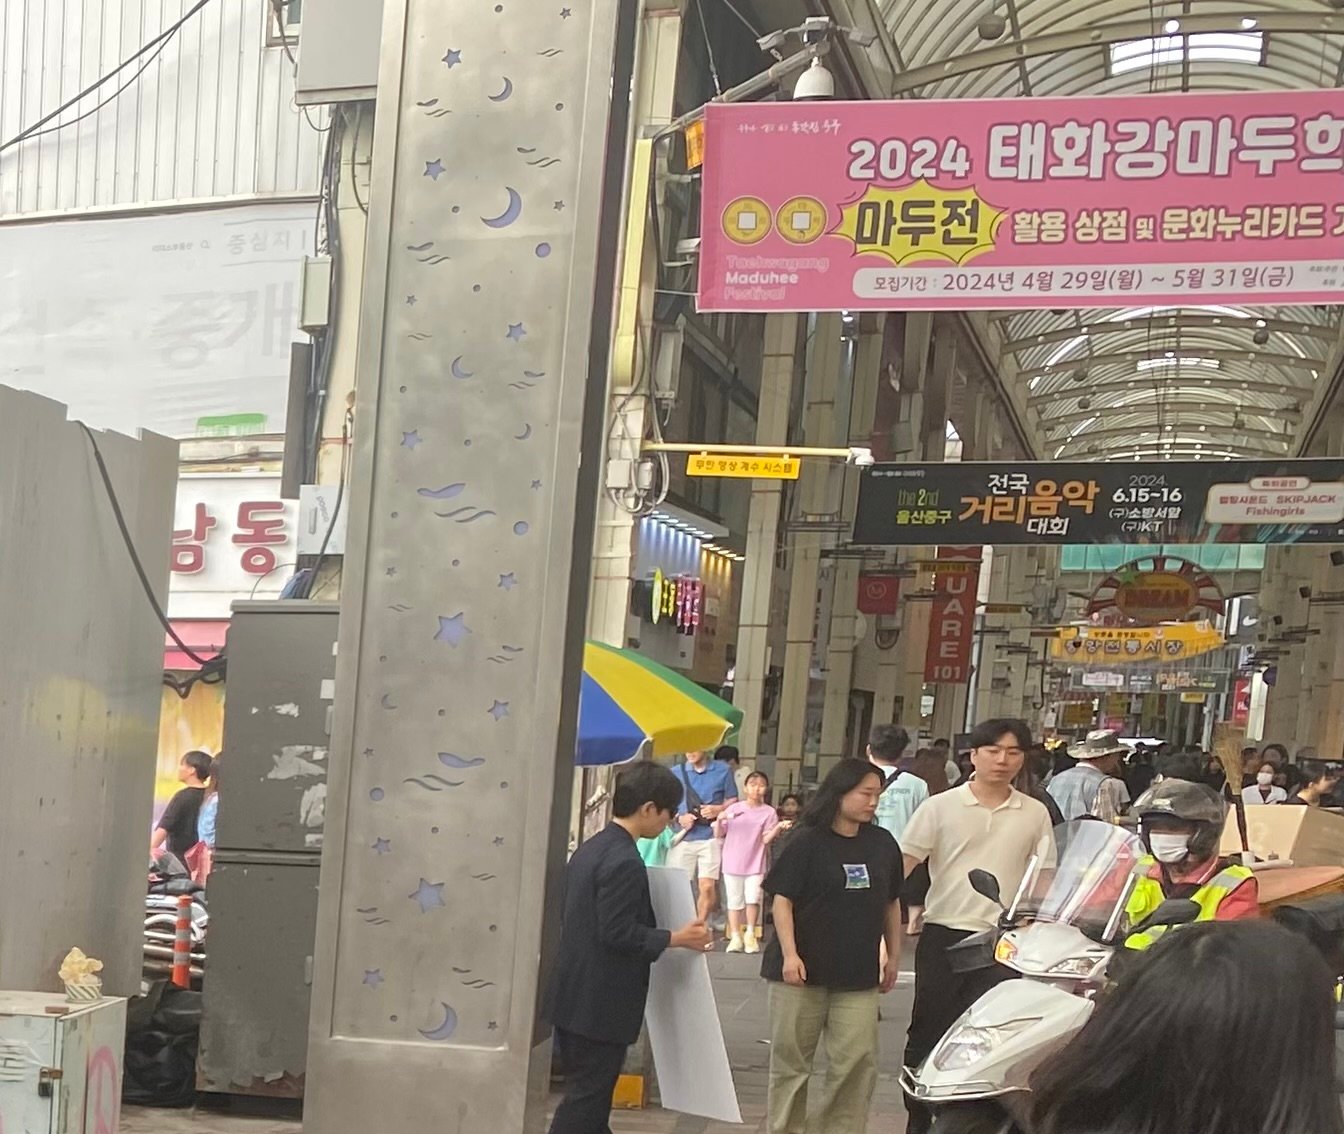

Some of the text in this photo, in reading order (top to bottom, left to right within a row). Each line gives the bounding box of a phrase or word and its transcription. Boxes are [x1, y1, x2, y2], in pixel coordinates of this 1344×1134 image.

[848, 138, 970, 179] 2024
[856, 199, 1324, 246] 마두전 활용 상점 및 문화누리카드
[725, 271, 799, 285] Maduhee
[874, 276, 927, 291] 모집기간
[943, 272, 1014, 291] 2024년
[1022, 271, 1053, 291] 4월
[1061, 269, 1143, 291] 29일(월)
[1171, 268, 1205, 289] 5월
[1211, 266, 1294, 288] 31일(금)
[988, 473, 1030, 495] 전국
[958, 480, 1101, 525] 거리음악
[1112, 488, 1183, 503] 6.15~16
[1276, 495, 1337, 504] SKIPJACK
[896, 510, 952, 524] 울산중구
[1026, 517, 1070, 535] 대회
[933, 666, 961, 679] 101
